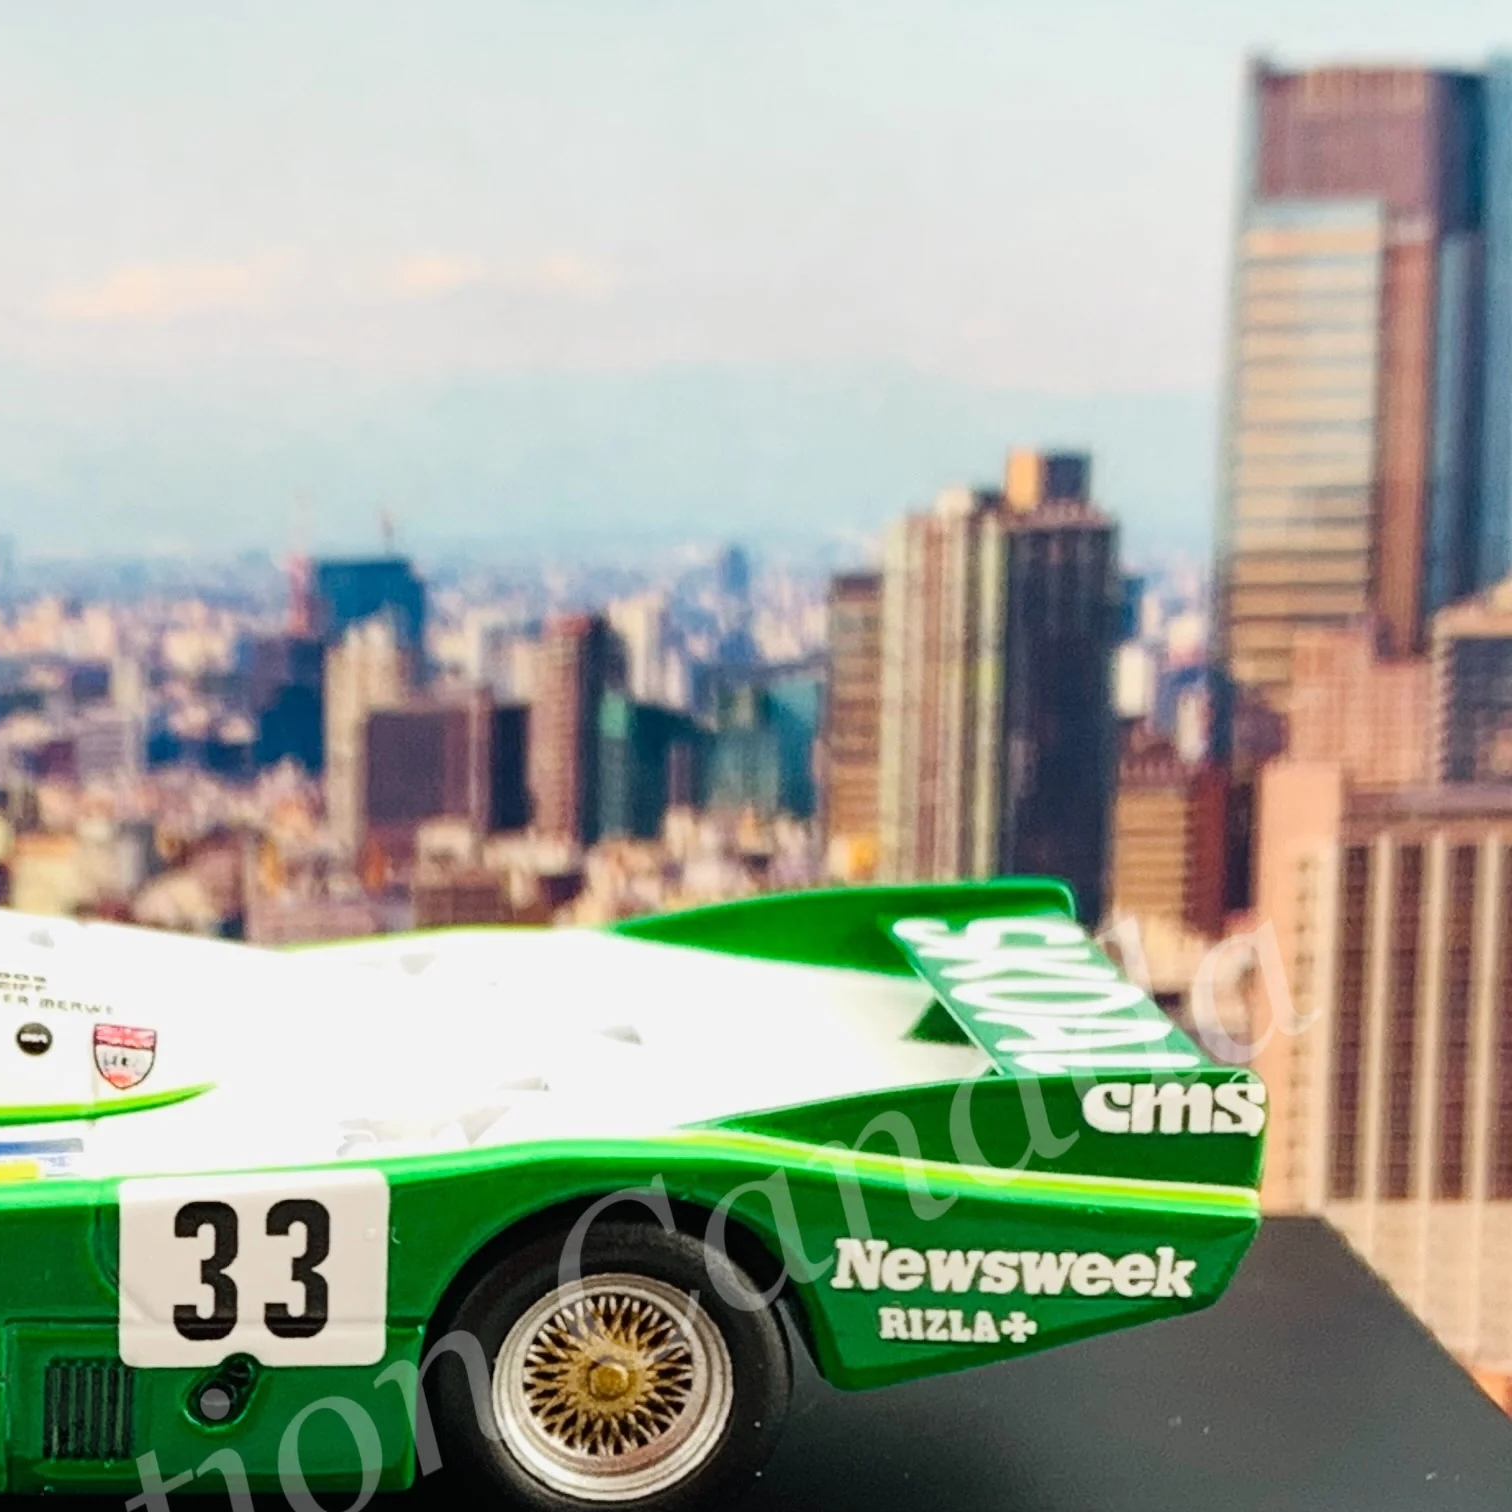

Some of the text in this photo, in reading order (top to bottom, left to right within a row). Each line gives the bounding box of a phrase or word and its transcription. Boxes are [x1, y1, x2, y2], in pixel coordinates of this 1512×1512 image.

[893, 916, 1201, 1074] SKOAL
[172, 1198, 332, 1342] 33
[830, 1237, 1196, 1298] Newsweek
